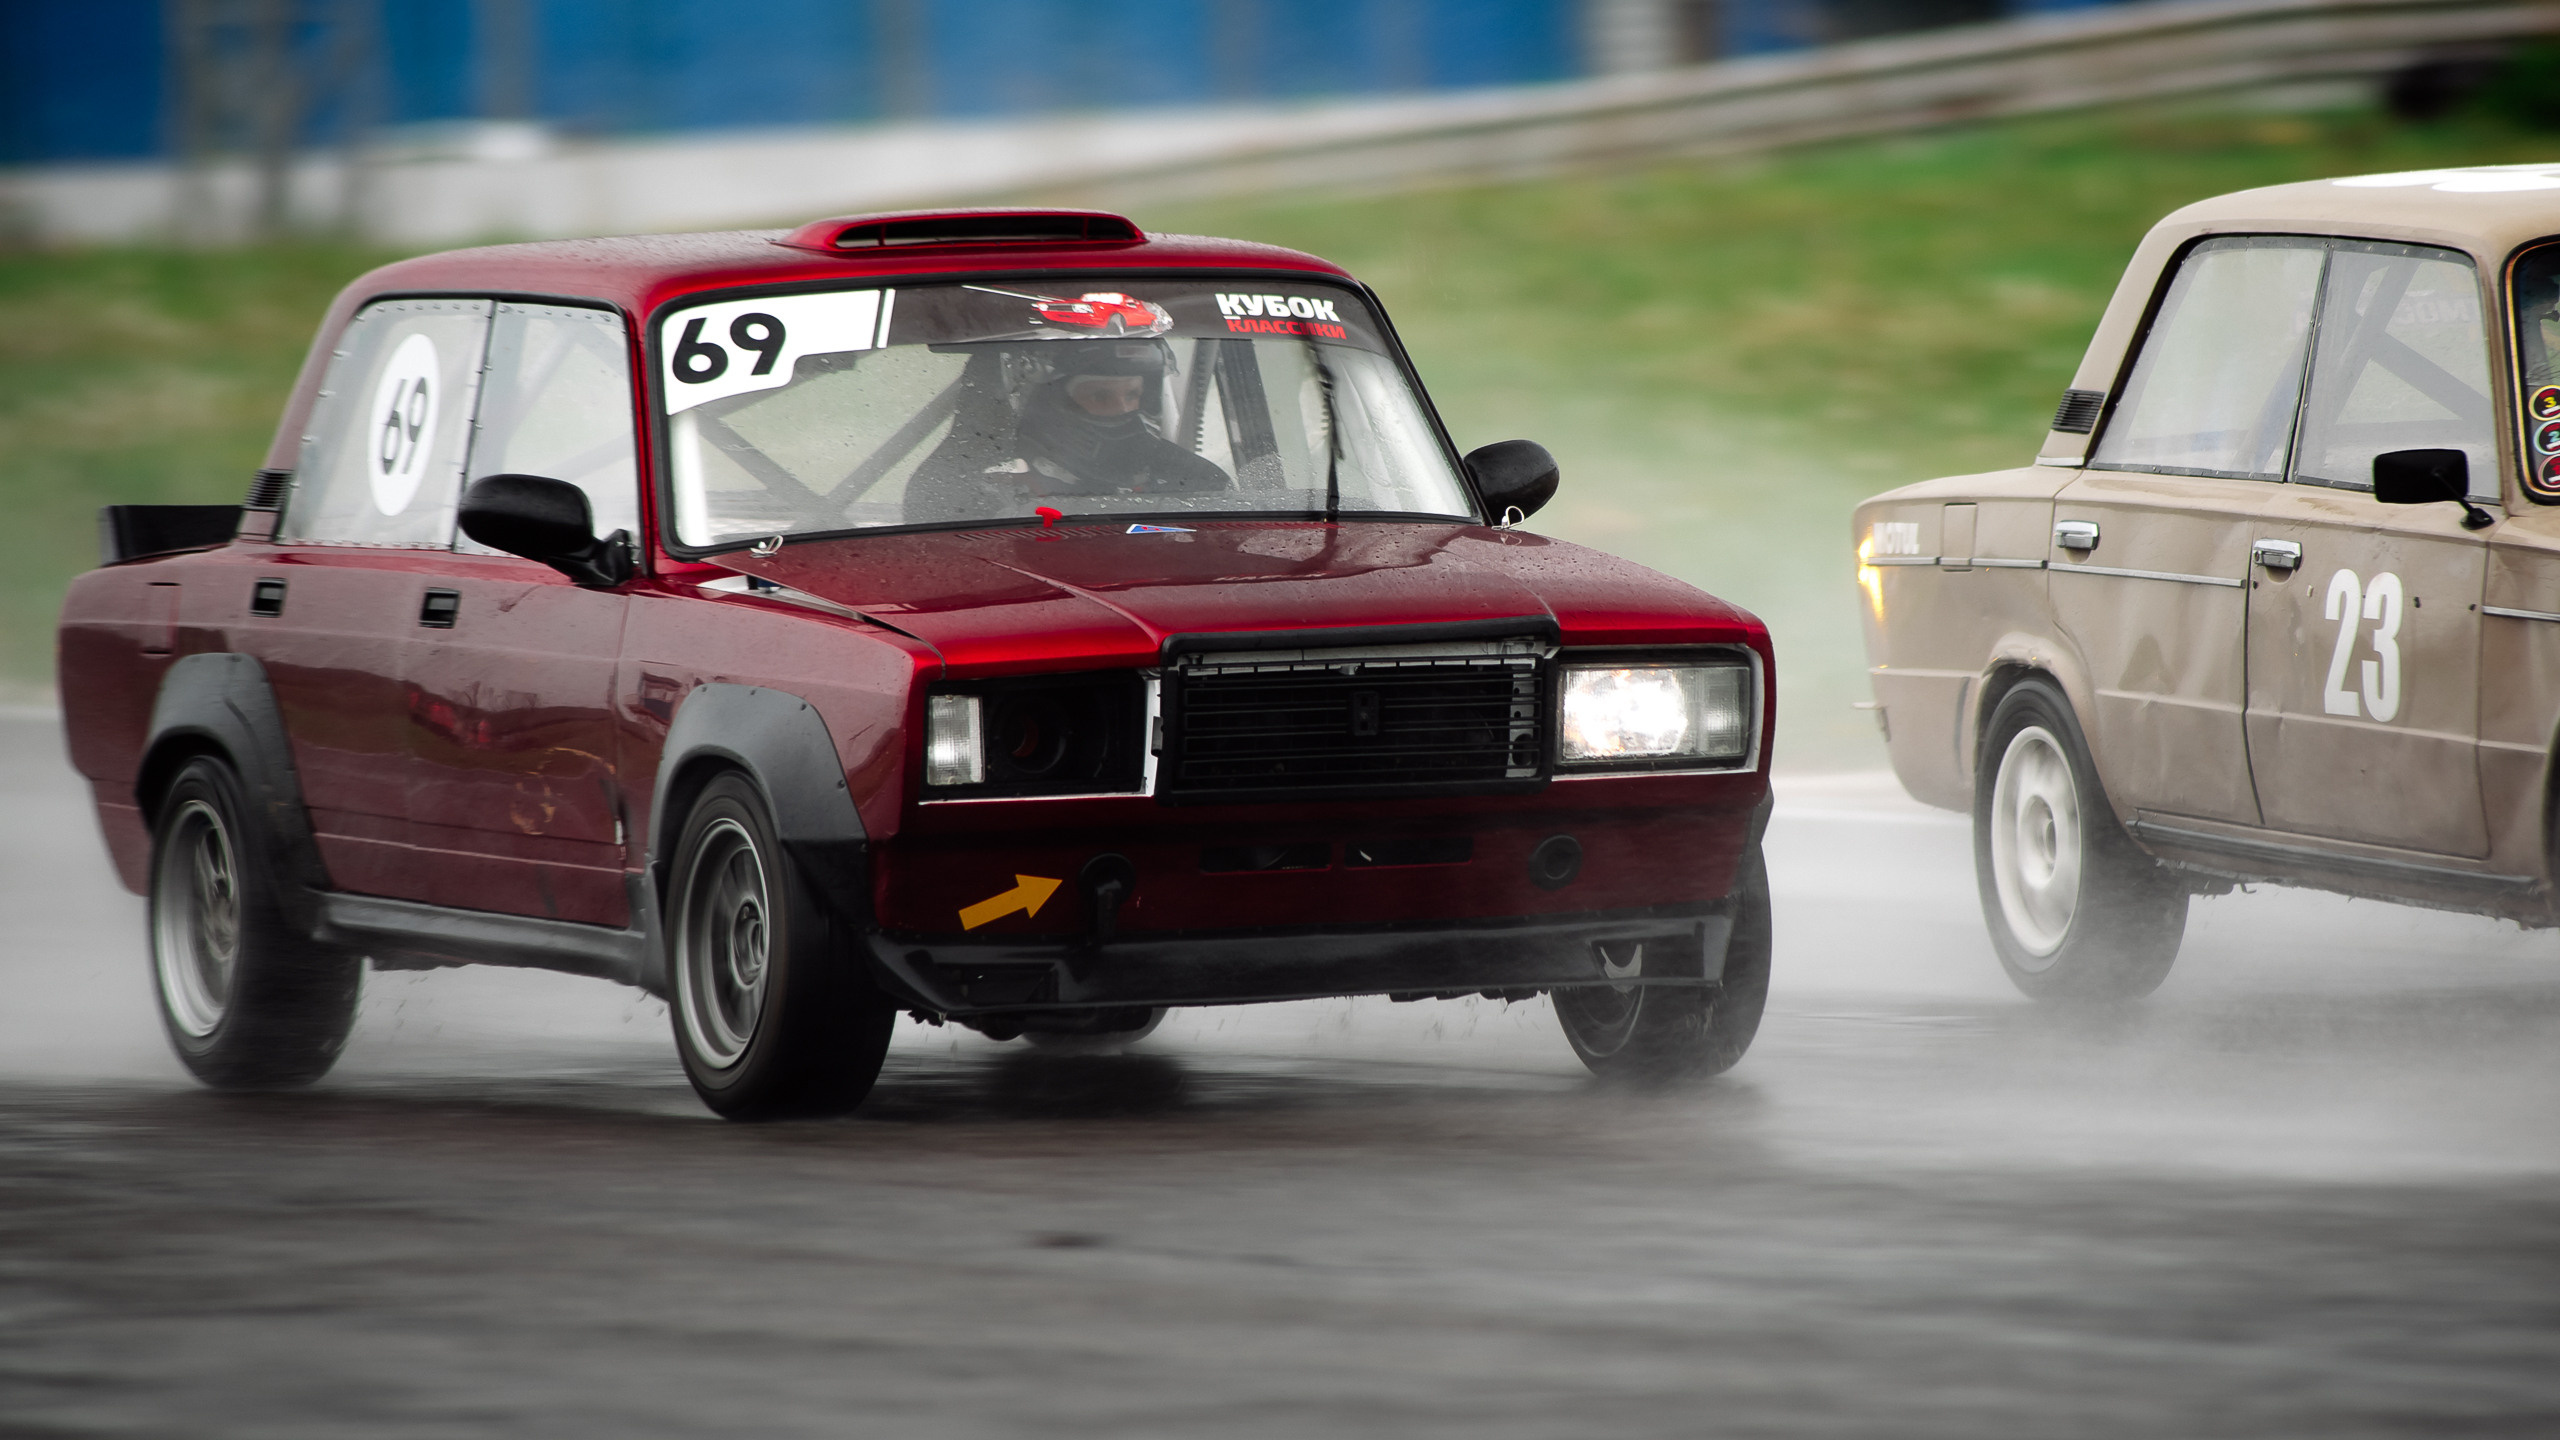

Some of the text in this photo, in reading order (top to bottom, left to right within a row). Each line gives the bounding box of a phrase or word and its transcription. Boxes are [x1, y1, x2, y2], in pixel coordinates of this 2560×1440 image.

[1215, 293, 1341, 323] КУБОК
[1225, 318, 1348, 340] КЛАССИКИ
[672, 312, 787, 385] 69
[381, 376, 429, 476] 69
[2543, 396, 2557, 408] 3
[2324, 568, 2404, 723] 23
